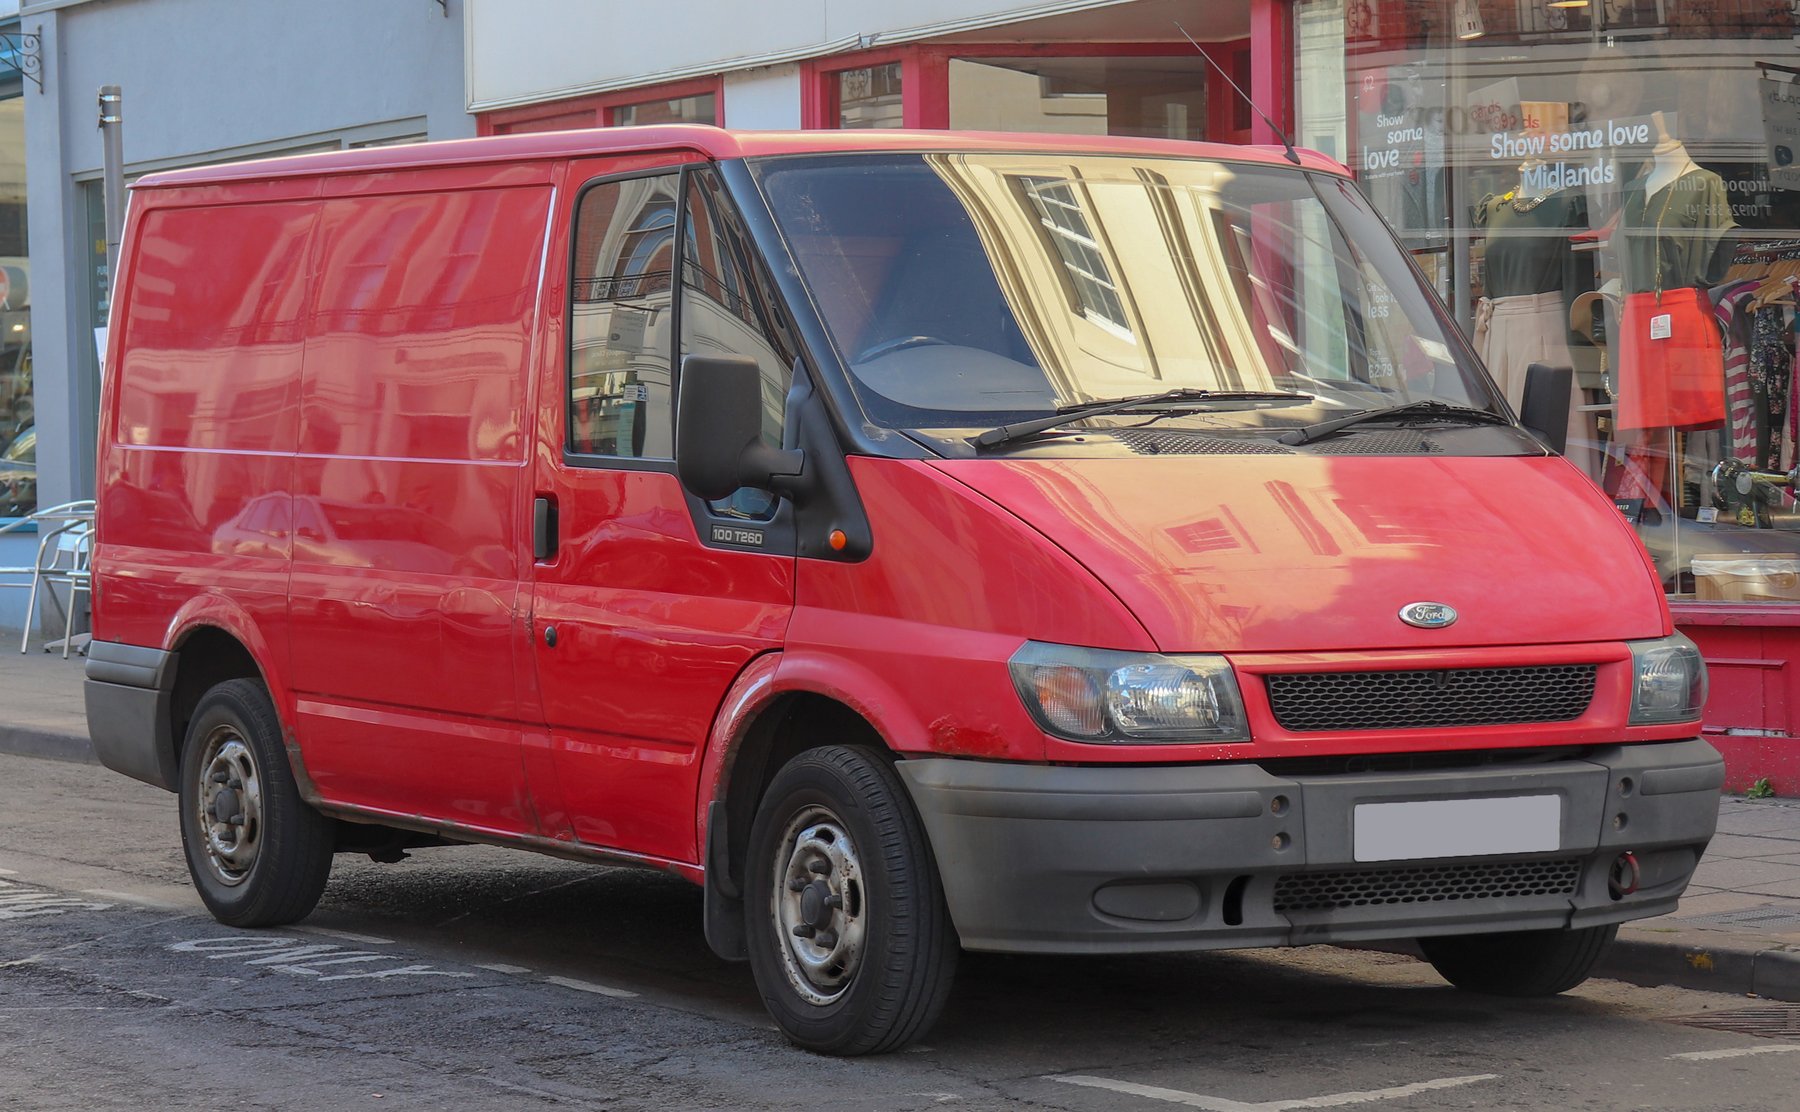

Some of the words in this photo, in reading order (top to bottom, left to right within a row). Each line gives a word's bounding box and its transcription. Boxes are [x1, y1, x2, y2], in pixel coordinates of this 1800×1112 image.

[1376, 114, 1404, 128] Show
[1387, 127, 1423, 144] some
[1491, 132, 1546, 160] Show
[1550, 128, 1604, 153] some
[1608, 120, 1649, 146] love
[1363, 145, 1400, 171] love
[1523, 158, 1615, 190] Midlands
[1367, 301, 1390, 319] less
[713, 528, 733, 541] 100
[734, 530, 763, 545] T260
[1415, 605, 1445, 620] Ford
[165, 936, 478, 982] ONLY
